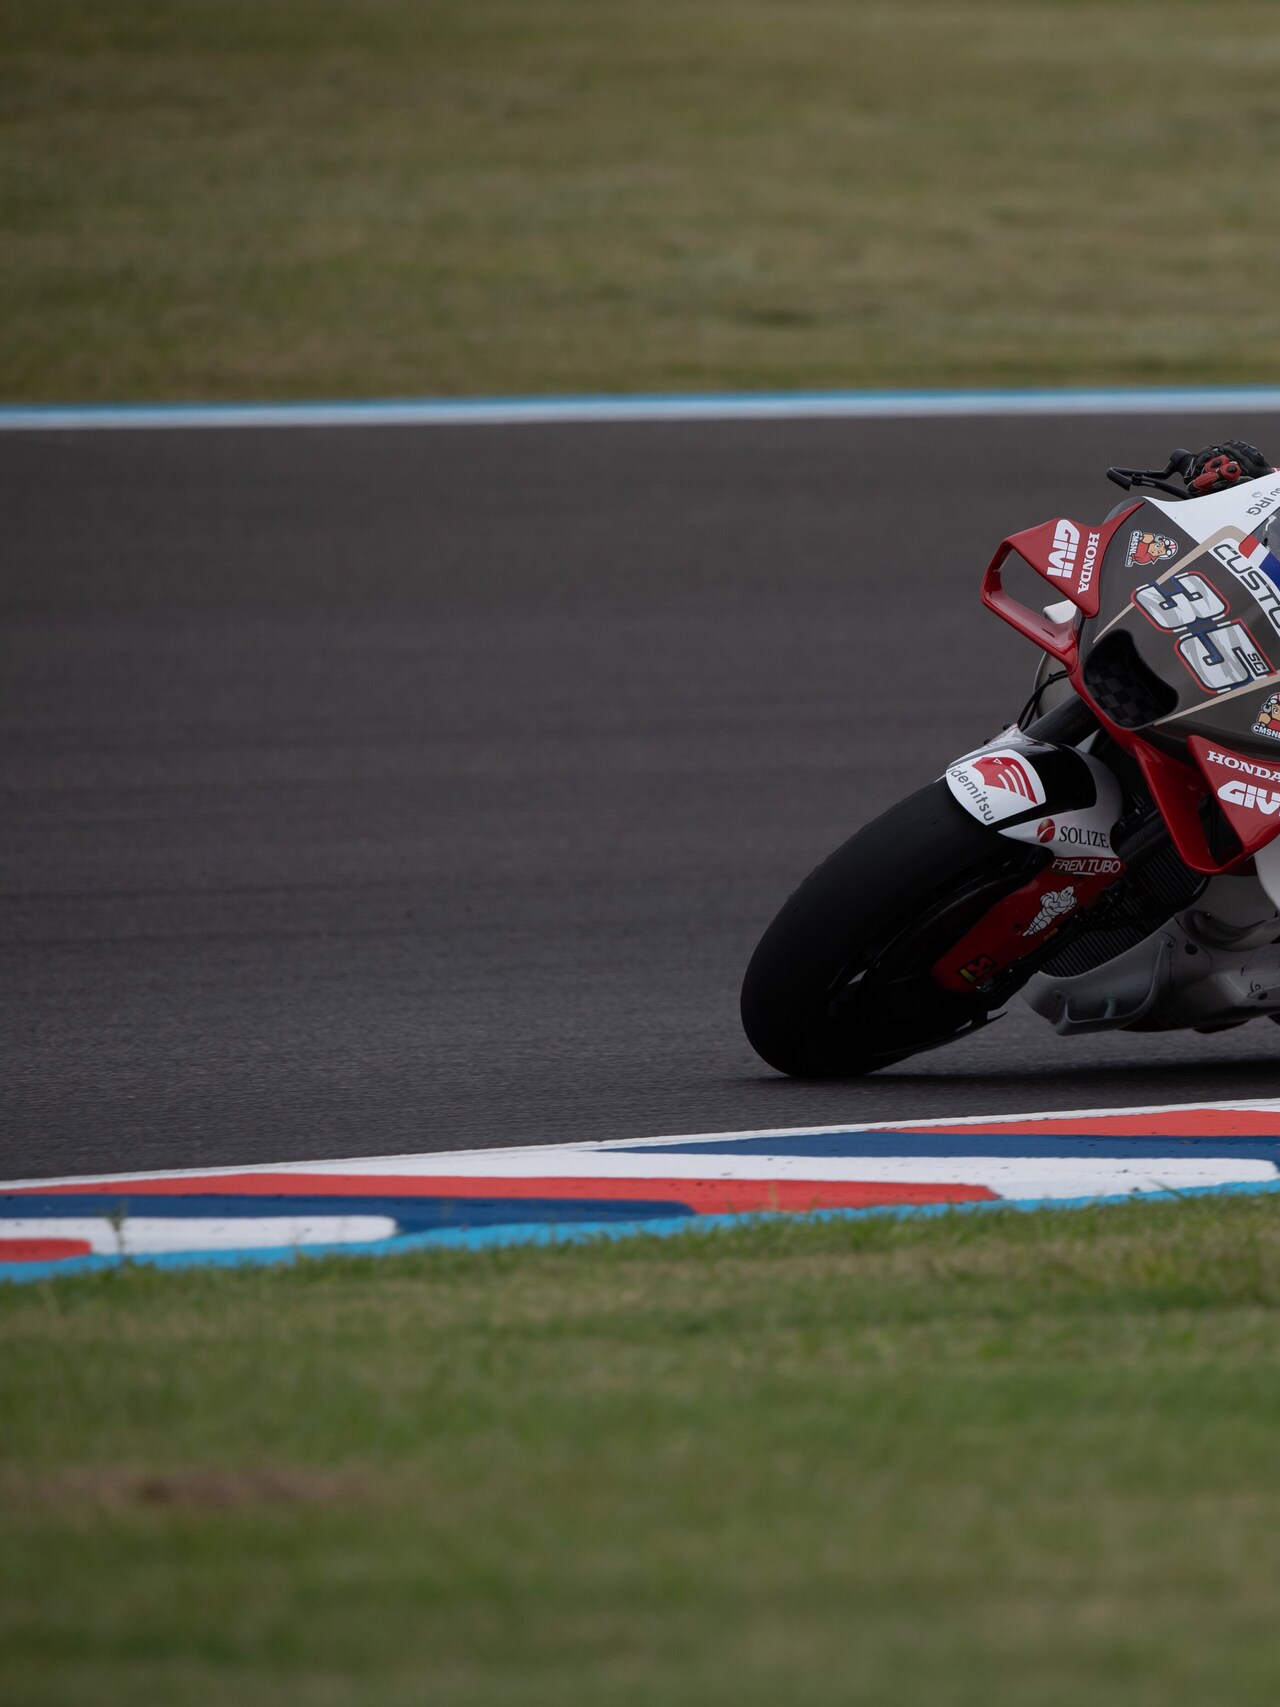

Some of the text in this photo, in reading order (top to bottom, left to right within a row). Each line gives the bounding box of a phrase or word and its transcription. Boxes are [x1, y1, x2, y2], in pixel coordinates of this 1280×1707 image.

[1246, 496, 1273, 516] IRG
[1047, 519, 1080, 579] GIVI
[1078, 532, 1100, 594] HONDA
[1131, 570, 1277, 694] 35
[949, 766, 994, 822] idemitsu
[1059, 826, 1109, 848] SOLIZE
[1051, 859, 1121, 874] FREN TUBO
